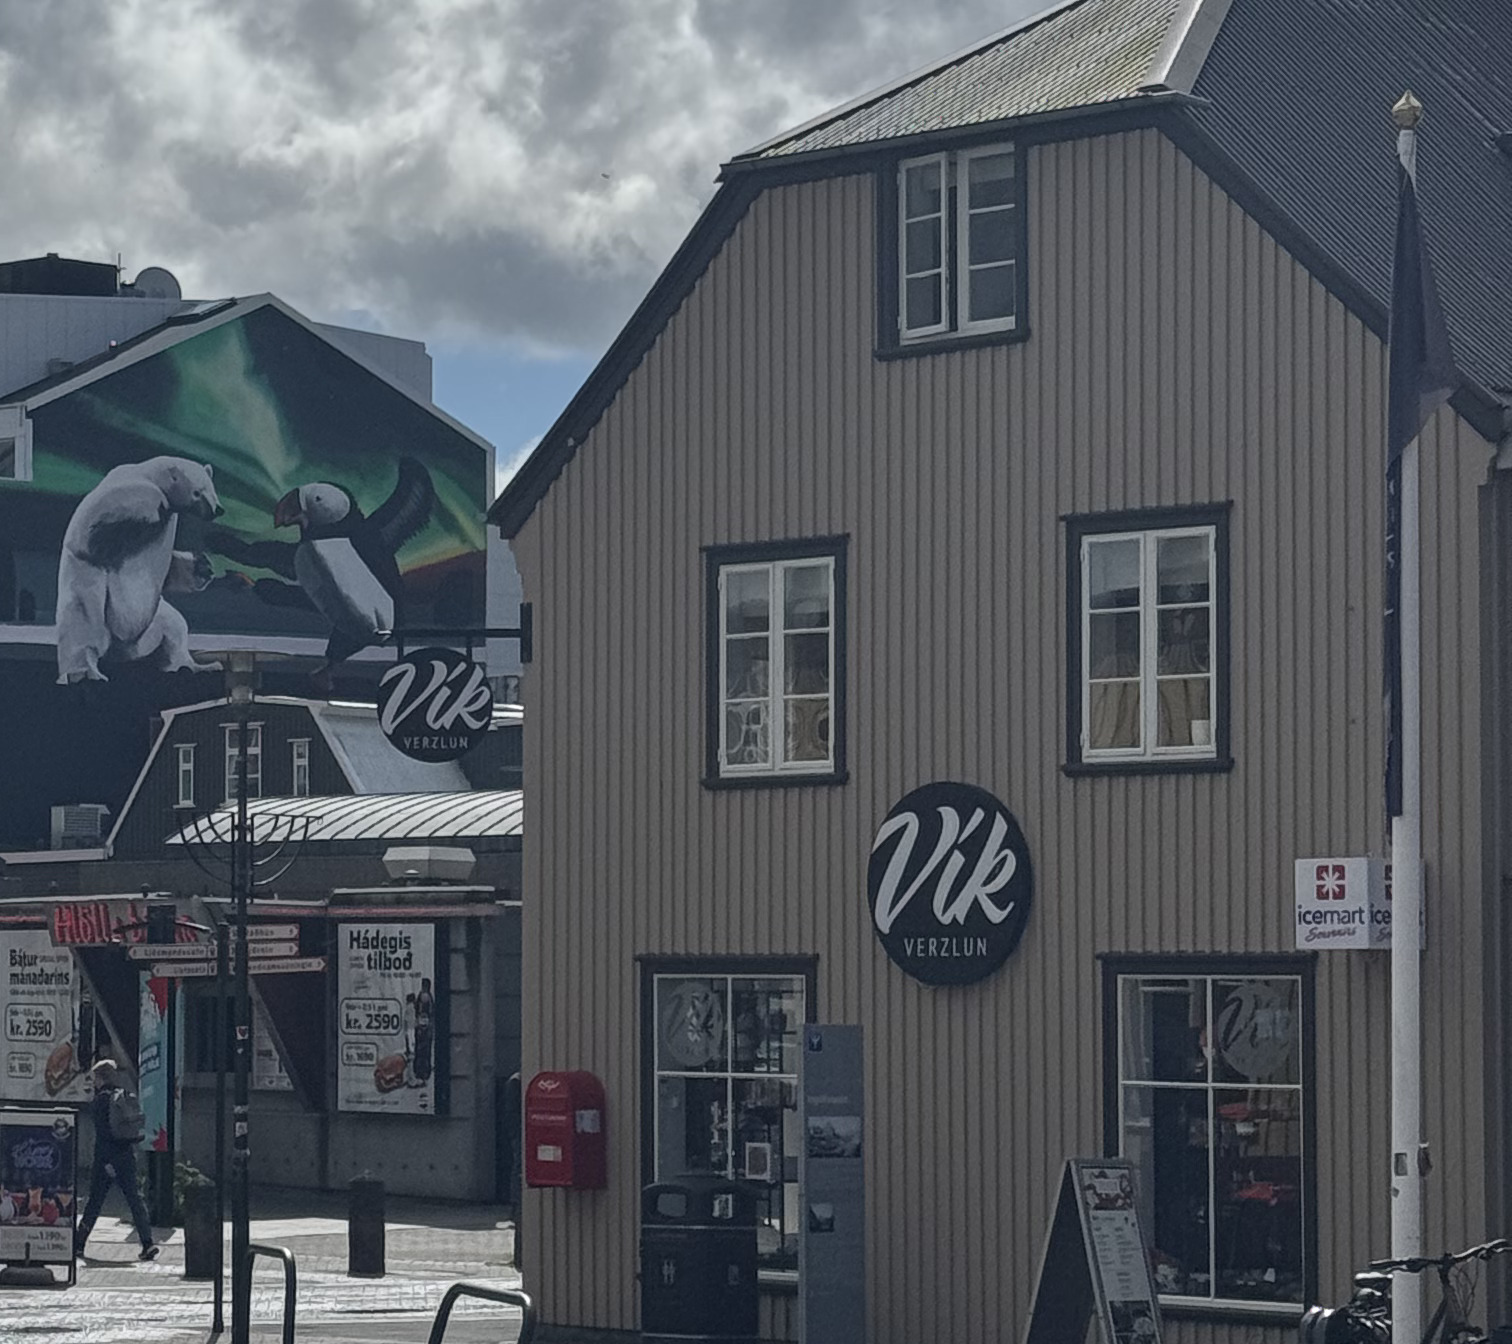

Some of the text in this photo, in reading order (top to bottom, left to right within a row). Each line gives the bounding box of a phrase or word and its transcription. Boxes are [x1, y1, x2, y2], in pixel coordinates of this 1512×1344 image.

[379, 660, 491, 736] Vík
[403, 736, 469, 749] VERZLUN
[872, 806, 1017, 935] Vík
[1297, 904, 1365, 925] icemart
[349, 929, 412, 954] Hádegis
[904, 937, 987, 957] VERZLUN
[9, 948, 38, 967] Bátur
[367, 951, 413, 971] tilboð
[9, 966, 70, 986] mánaðarins
[9, 1019, 52, 1037] kr. 2590
[345, 1013, 400, 1031] kr. 2590
